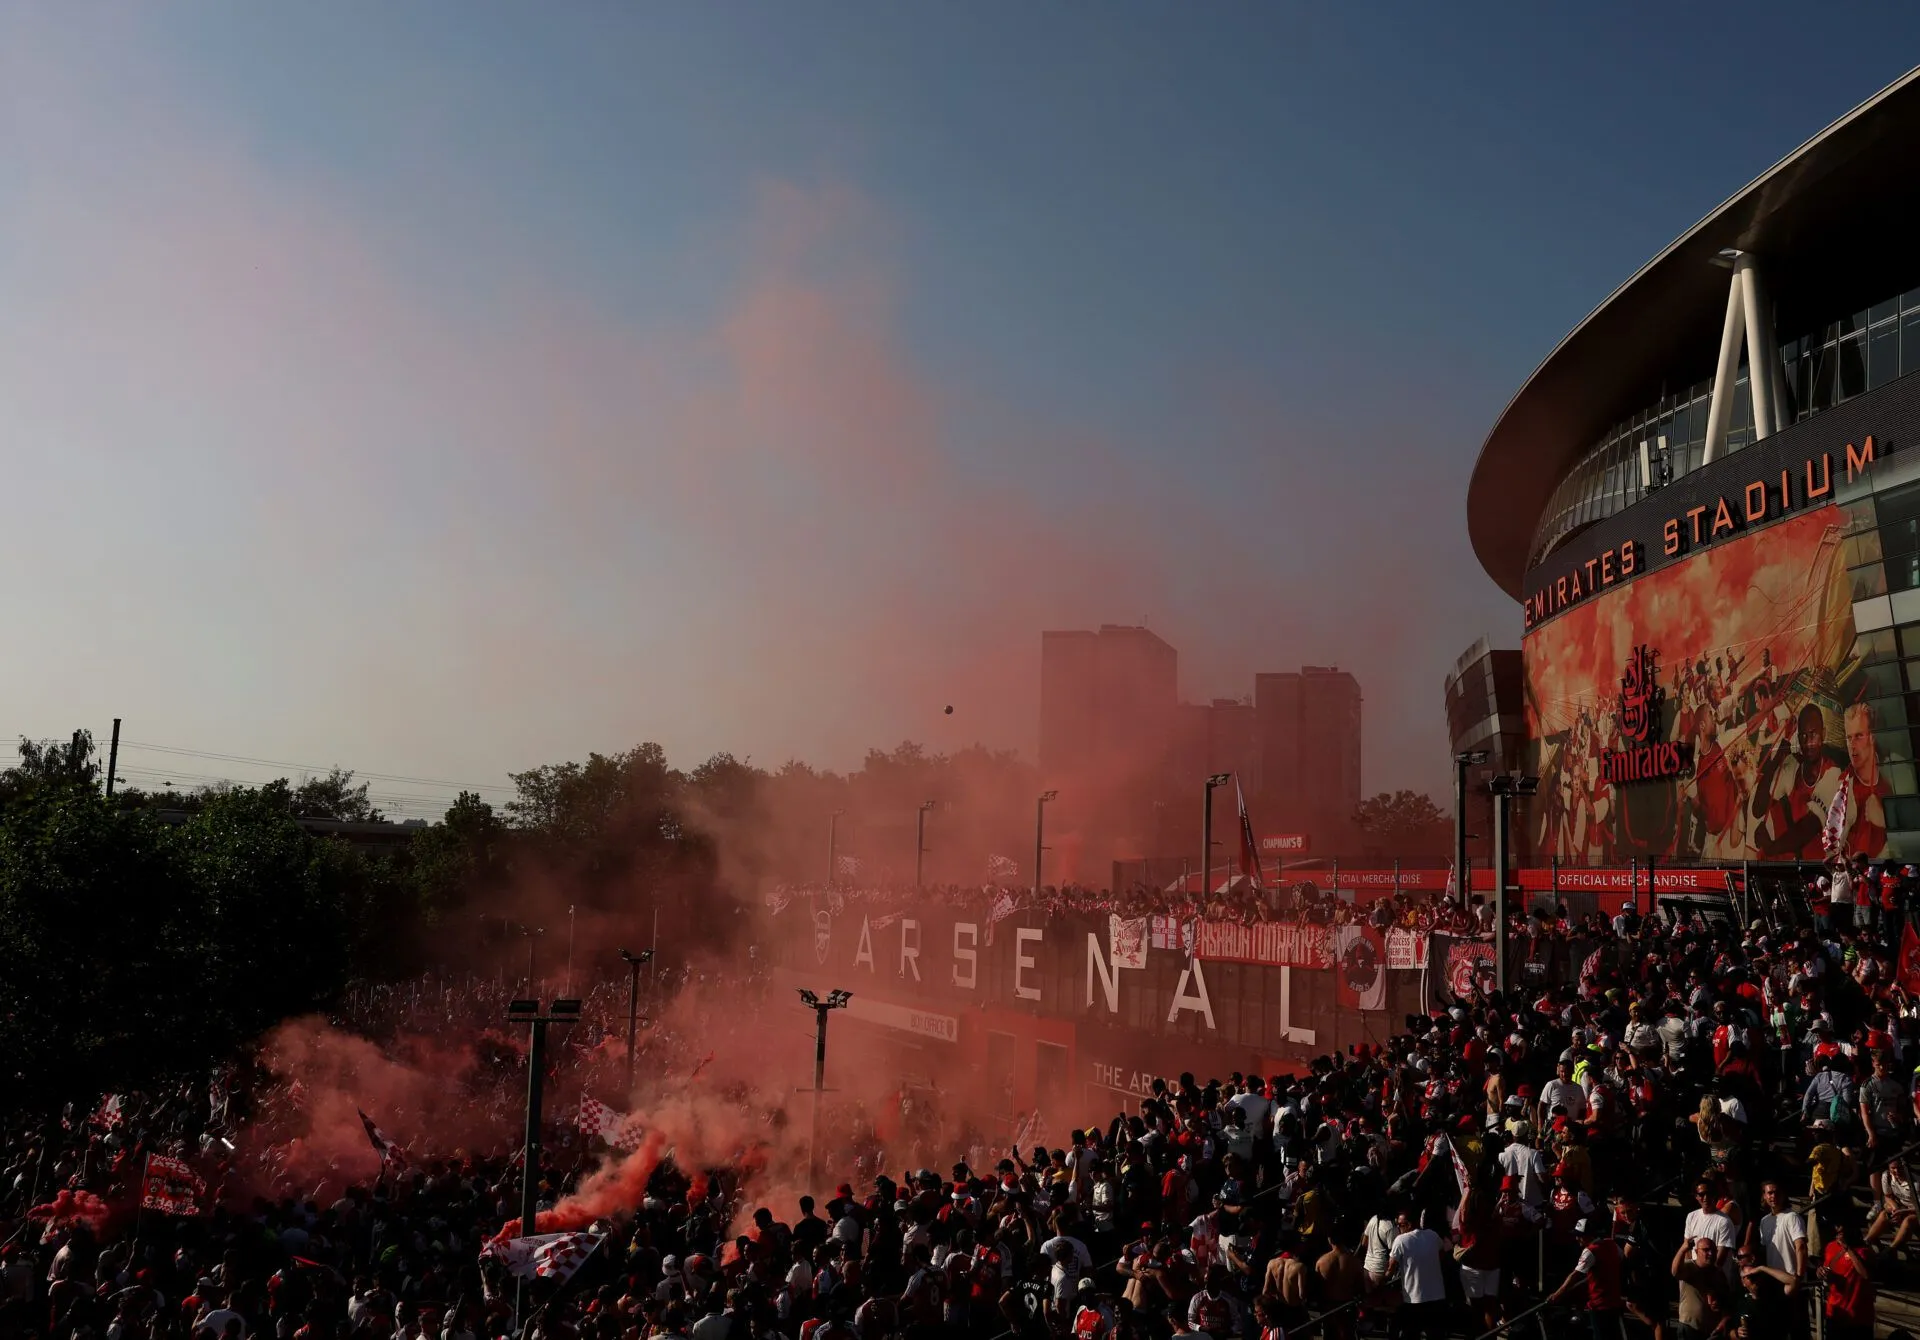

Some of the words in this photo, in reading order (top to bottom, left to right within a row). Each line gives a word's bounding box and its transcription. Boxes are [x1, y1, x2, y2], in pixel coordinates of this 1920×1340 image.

[1524, 540, 1635, 627] EMIRATES
[1663, 435, 1876, 556] STADIUM
[1600, 740, 1680, 784] Emirates
[1263, 837, 1296, 849] CHAPMAN'S
[1325, 873, 1361, 884] OFFICIAL
[1362, 873, 1421, 884] MERCHANDISE
[1558, 874, 1608, 886] OFFICIAL
[1611, 875, 1698, 887] MERCHANDISE
[854, 913, 1316, 1046] ARSENAL
[924, 1016, 946, 1036] OFFICE
[1092, 1062, 1123, 1088] THE
